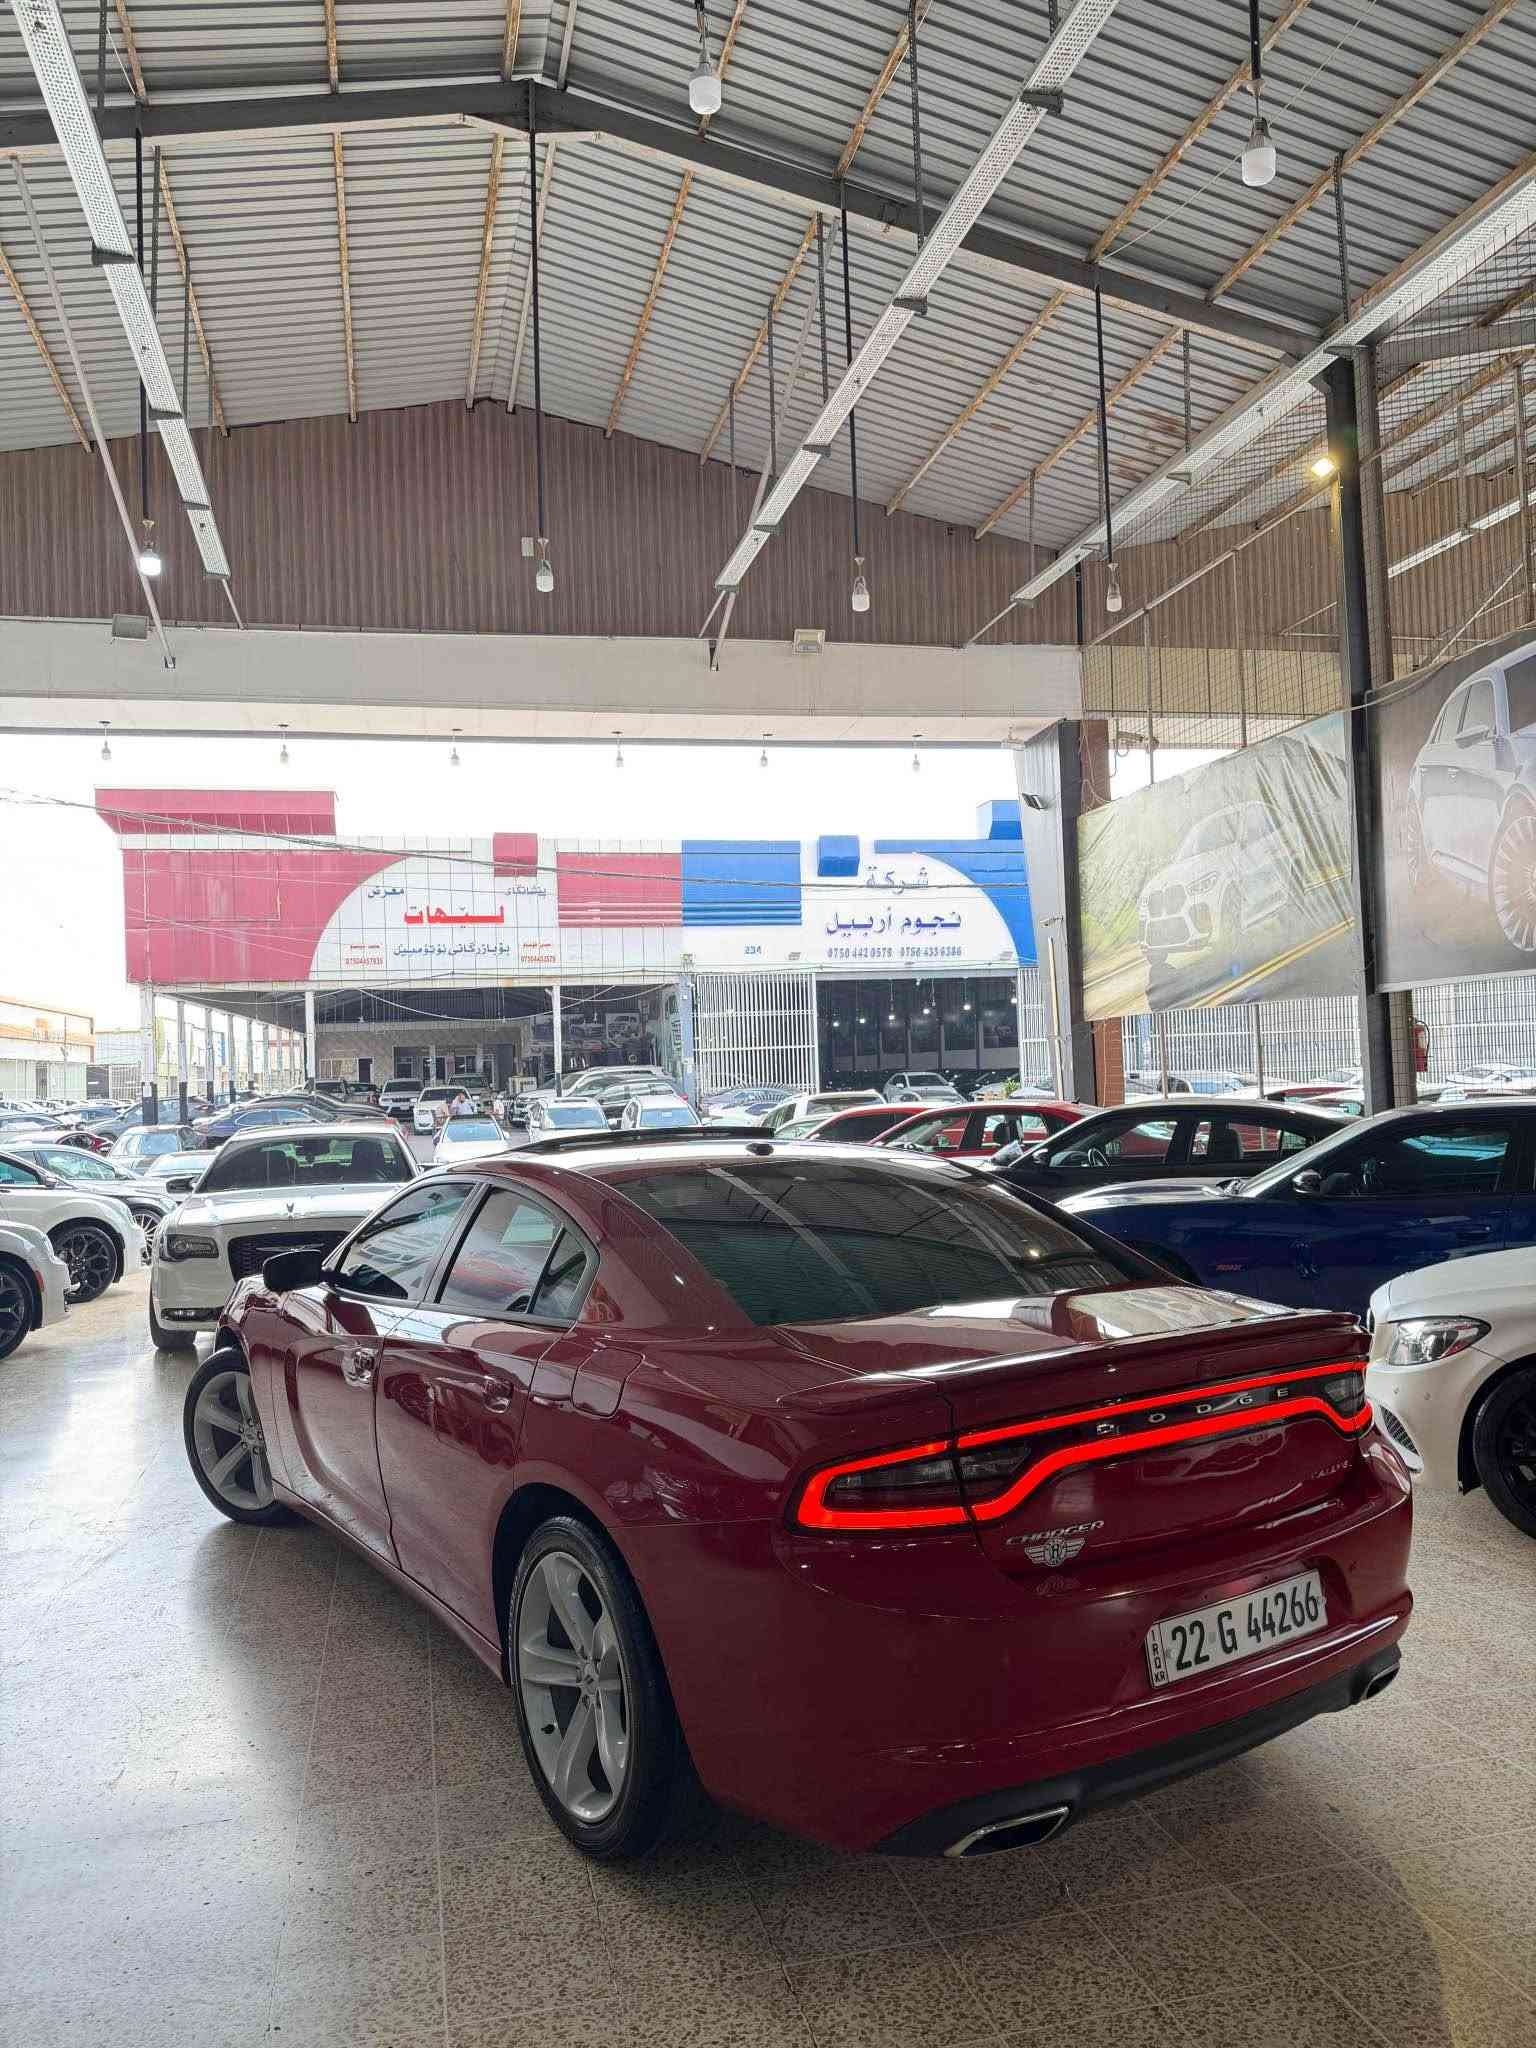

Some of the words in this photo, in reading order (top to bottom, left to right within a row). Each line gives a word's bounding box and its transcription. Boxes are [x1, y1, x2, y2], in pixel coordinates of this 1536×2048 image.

[865, 866, 928, 895] شركة
[901, 911, 961, 936] نجوم
[1096, 1386, 1290, 1435] DODGE
[1171, 1620, 1210, 1671] 22
[1217, 1610, 1238, 1654] G
[1247, 1581, 1319, 1643] 44266
